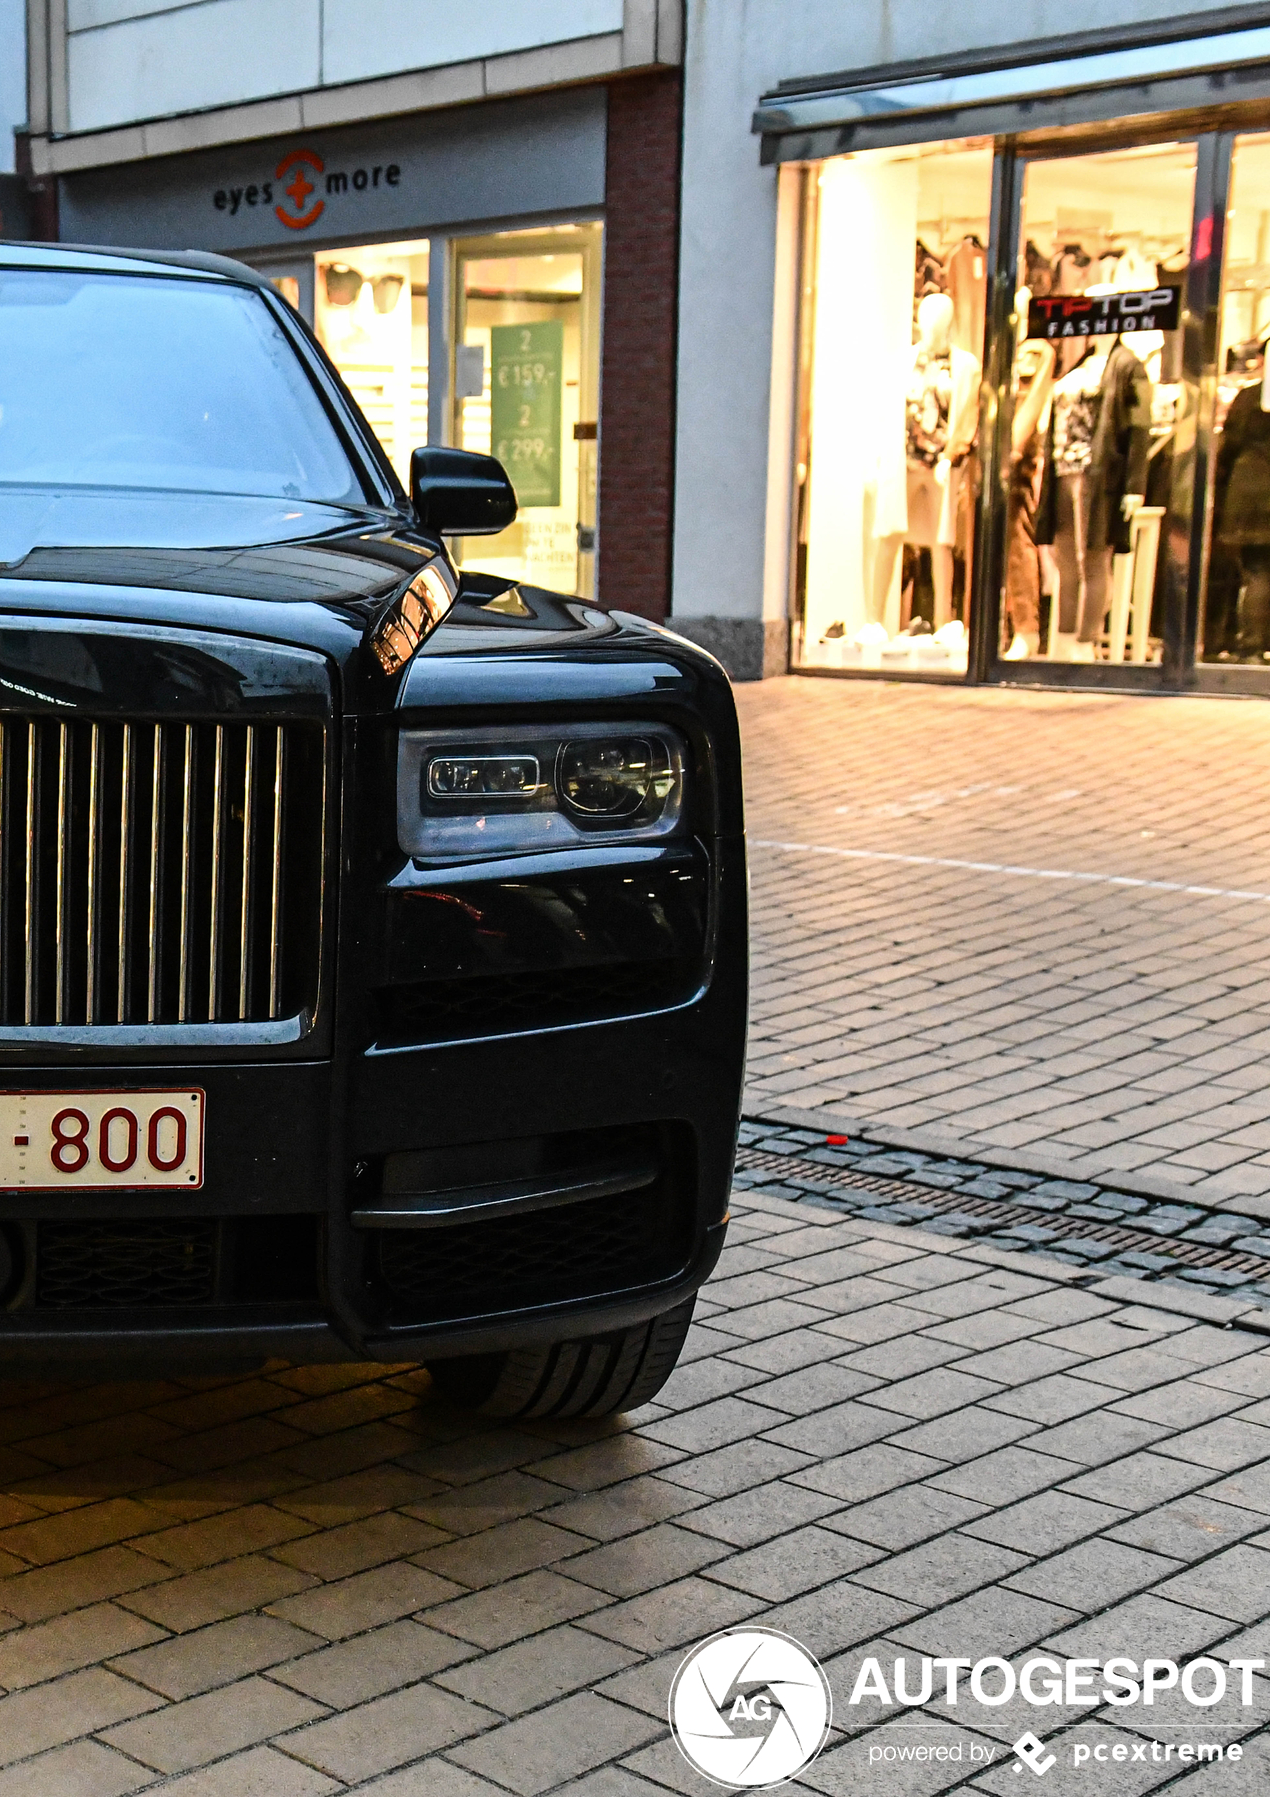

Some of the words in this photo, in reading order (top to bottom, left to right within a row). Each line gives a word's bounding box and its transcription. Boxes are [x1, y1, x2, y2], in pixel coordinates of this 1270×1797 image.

[214, 182, 273, 216] eyes
[326, 164, 401, 195] more
[1047, 315, 1156, 338] FASHION
